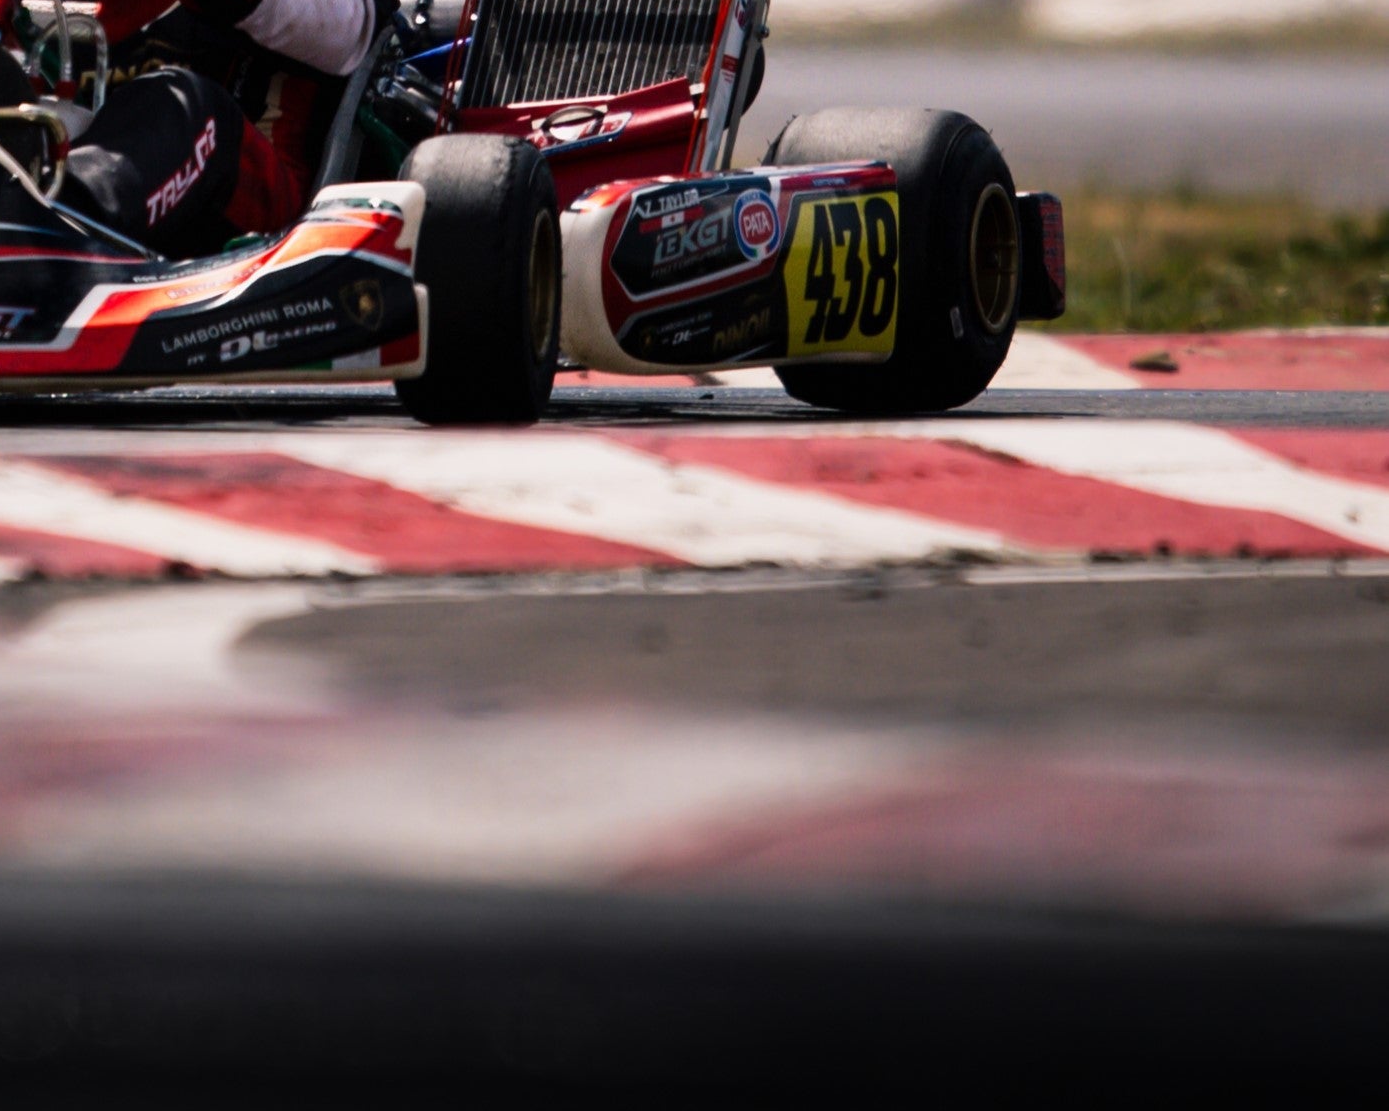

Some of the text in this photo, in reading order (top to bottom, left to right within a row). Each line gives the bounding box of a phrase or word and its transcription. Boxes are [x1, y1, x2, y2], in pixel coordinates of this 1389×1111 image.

[146, 118, 215, 226] TAYLOR
[659, 188, 700, 213] TAYLOR
[742, 211, 771, 239] PATA
[804, 196, 898, 344] 438
[162, 296, 334, 354] LAMBORGHINI ROMA
